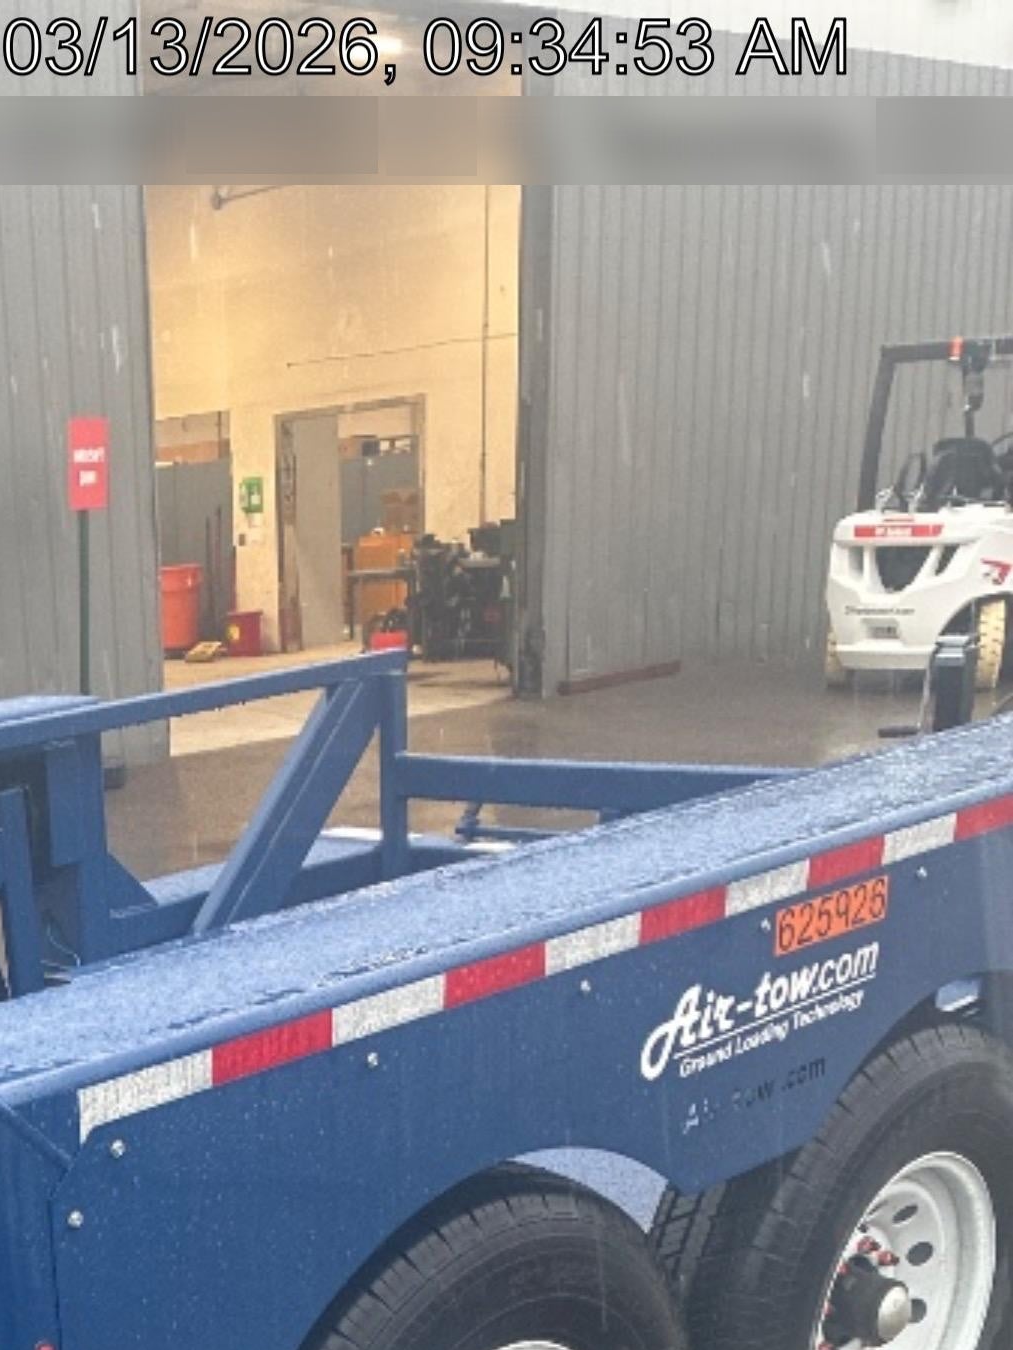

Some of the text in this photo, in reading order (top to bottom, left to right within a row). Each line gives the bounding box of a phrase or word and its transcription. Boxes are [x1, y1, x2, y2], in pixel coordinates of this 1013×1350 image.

[778, 877, 886, 951] 625926
[640, 942, 880, 1081] Air-tow.com
[679, 989, 865, 1078] Ground Loading Technology
